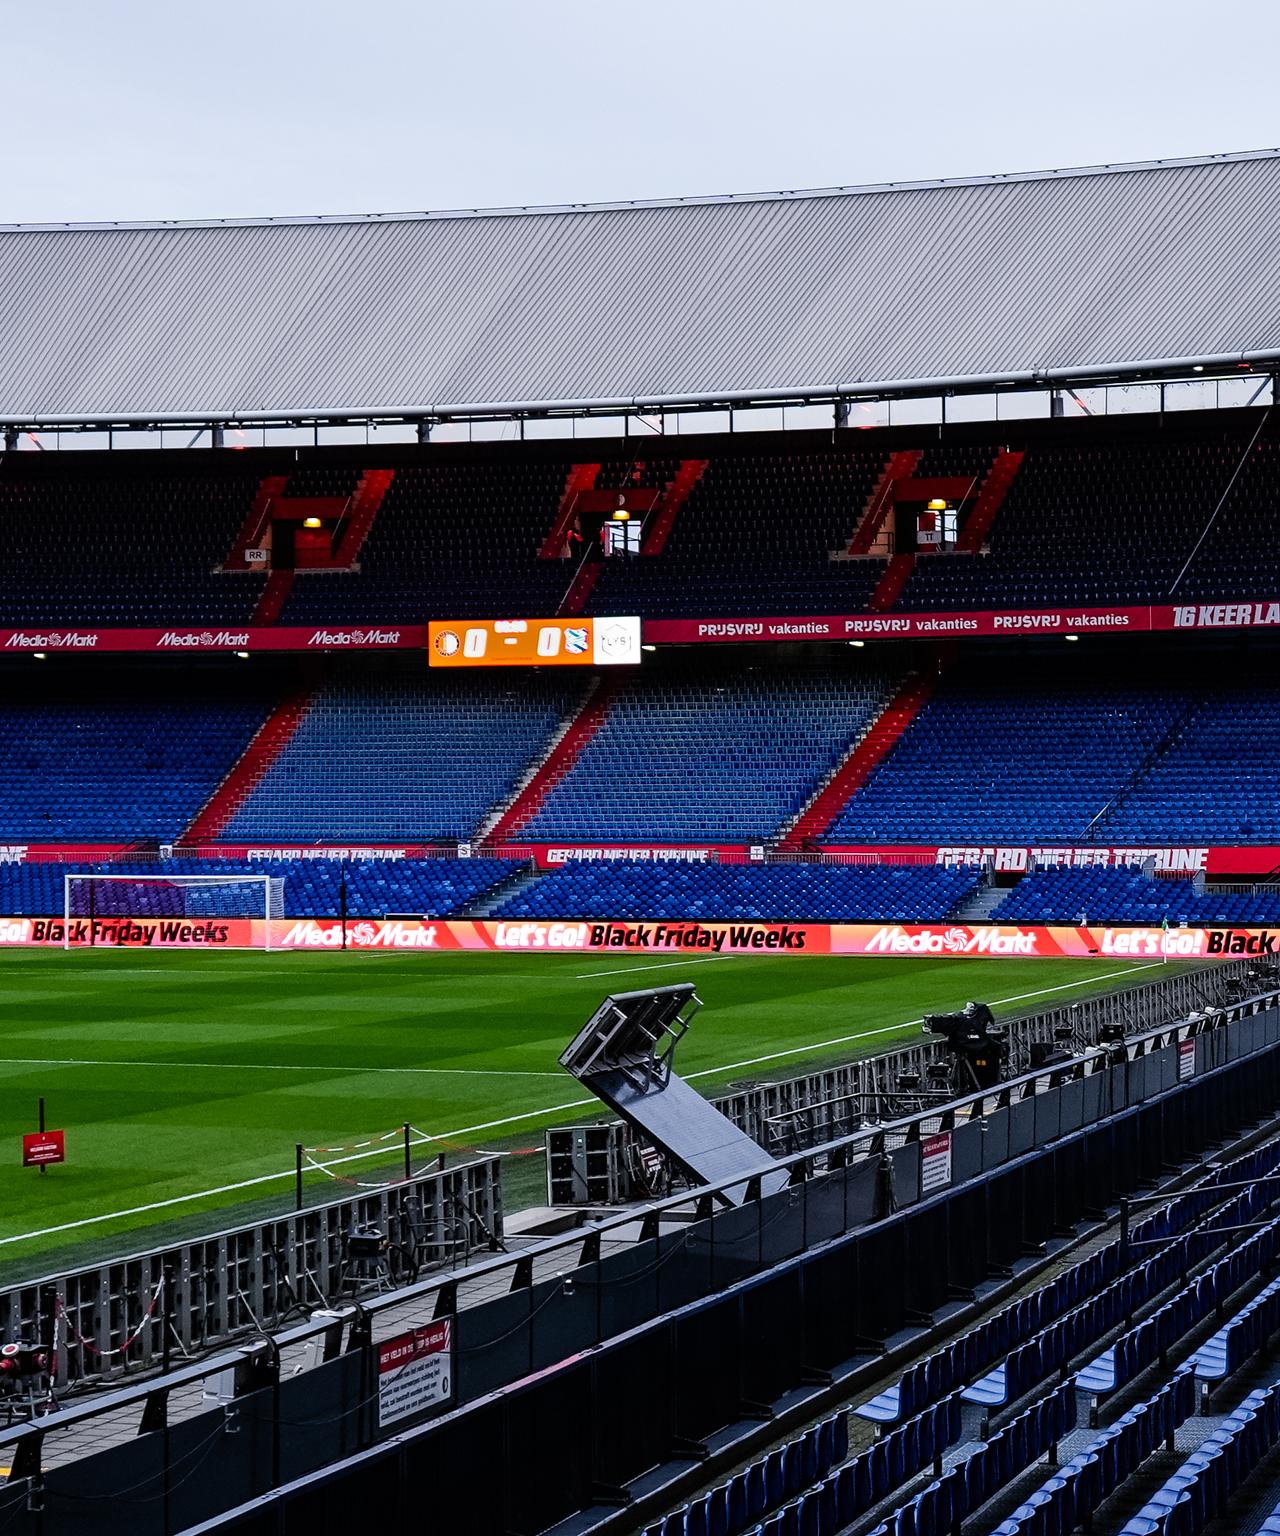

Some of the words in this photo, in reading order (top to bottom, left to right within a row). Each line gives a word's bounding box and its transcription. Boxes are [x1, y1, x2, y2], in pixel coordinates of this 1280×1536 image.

[916, 617, 978, 630] vakanties
[1066, 612, 1129, 626] vakanties
[1173, 606, 1196, 627] 16
[1197, 603, 1252, 626] KEER
[768, 621, 829, 635] vakanties
[32, 921, 89, 942] Black
[91, 921, 156, 946] Friday
[159, 921, 229, 943] Weeks
[494, 922, 547, 947] Let's
[547, 923, 588, 947] Go!
[589, 925, 652, 947] Black
[653, 925, 727, 952] Friday
[729, 926, 806, 949] Weeks
[1101, 929, 1159, 954] Let's
[1160, 929, 1205, 955] Go!
[1207, 931, 1275, 954] Black
